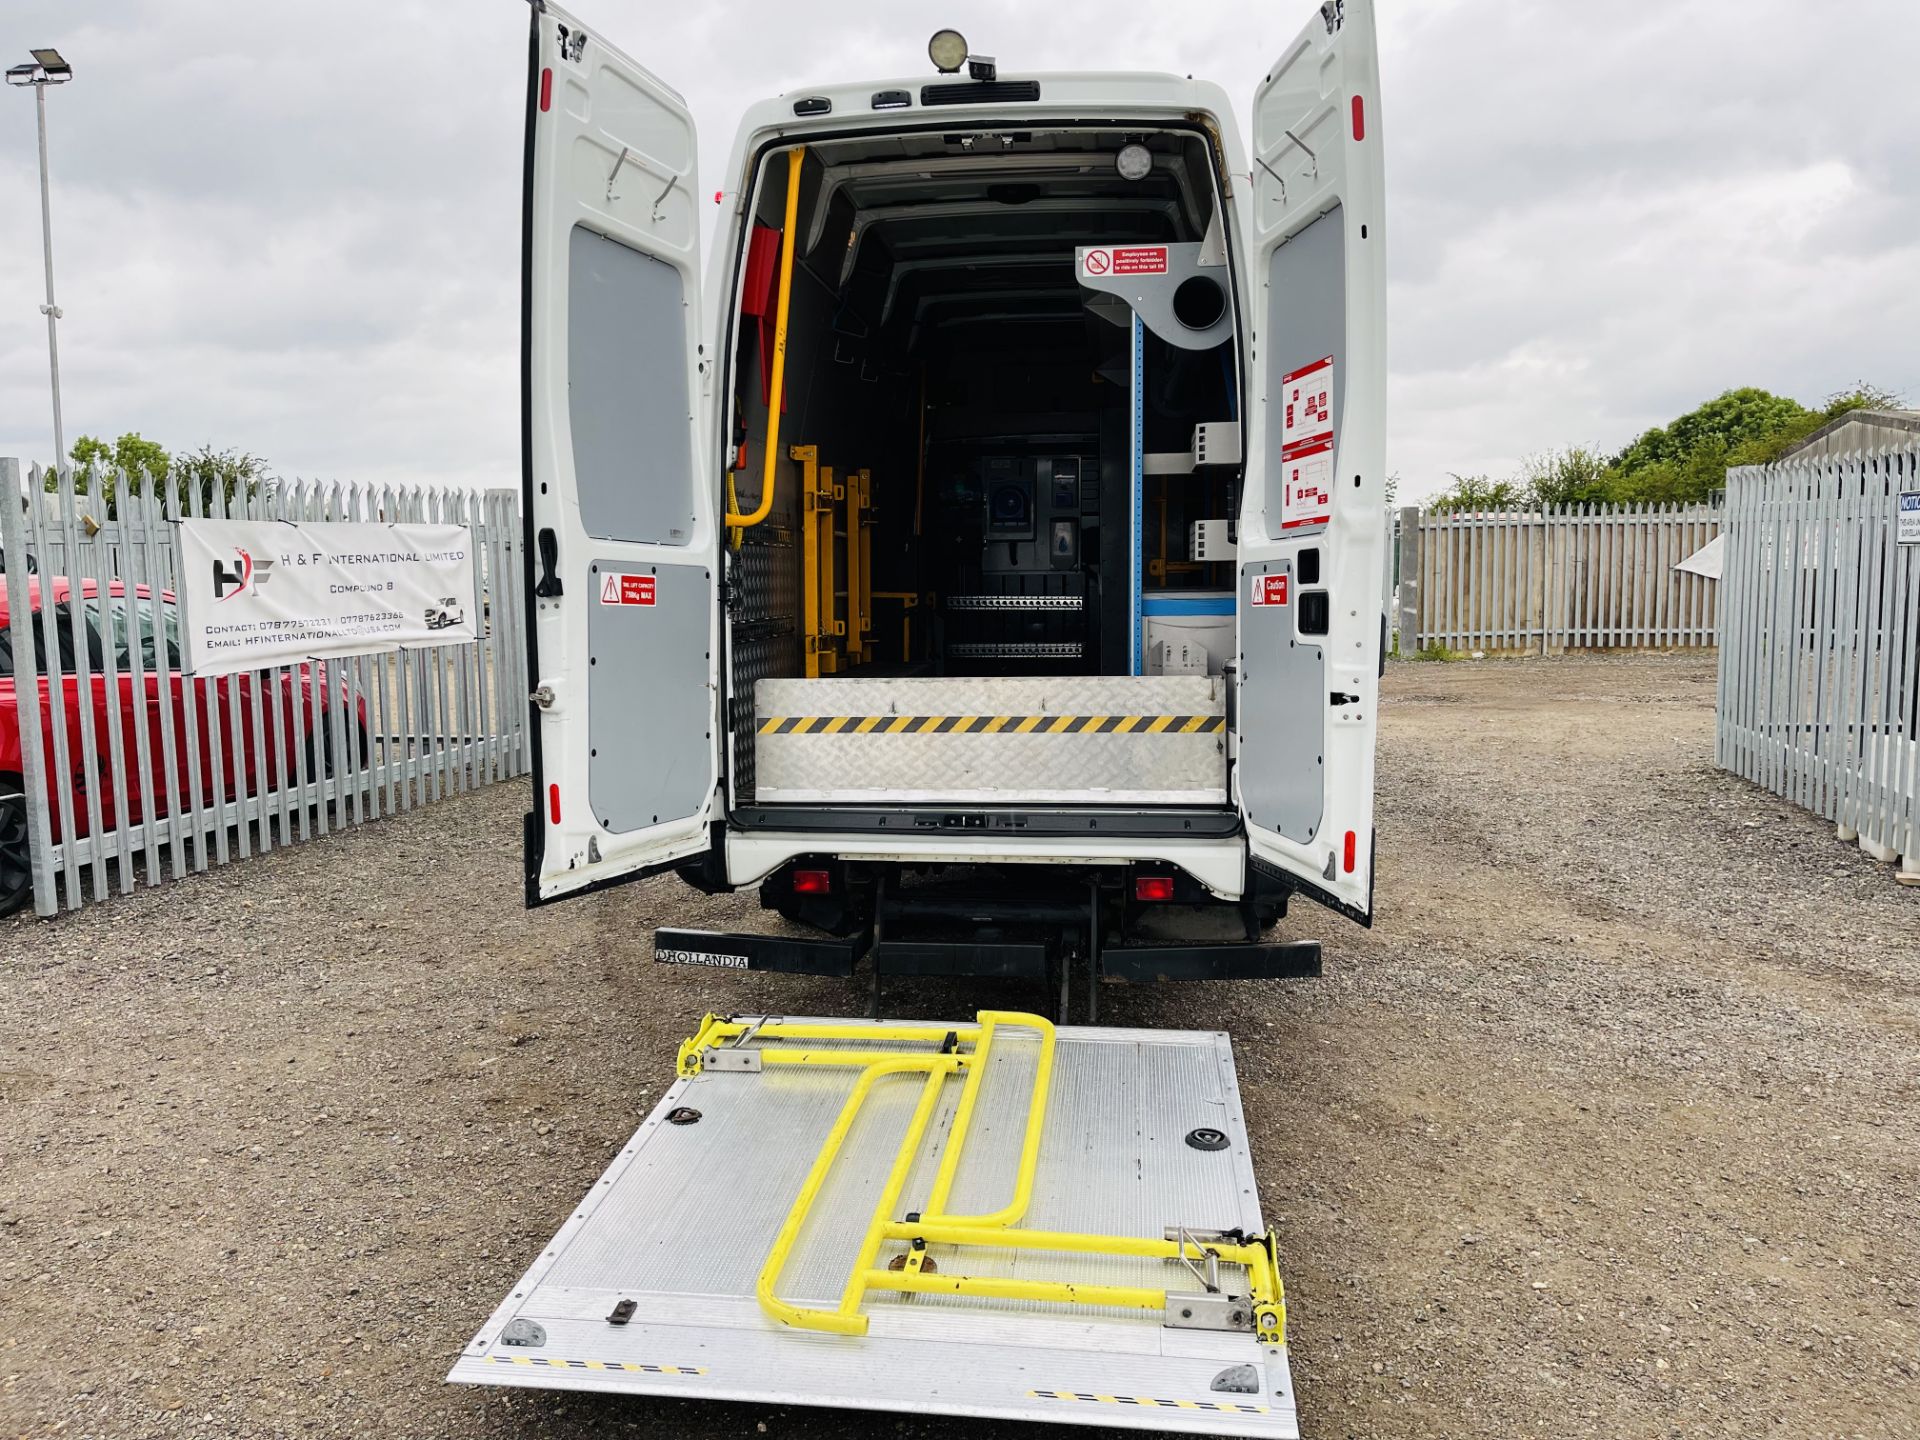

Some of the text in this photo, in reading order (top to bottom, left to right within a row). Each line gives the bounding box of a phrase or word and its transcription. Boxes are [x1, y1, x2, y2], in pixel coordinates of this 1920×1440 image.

[281, 551, 464, 566] H & F INTERNATIONAL LIMITED
[640, 591, 652, 600] MAX
[205, 623, 256, 634] CONTACT:
[207, 639, 241, 649] EMAIL:
[656, 949, 747, 969] DHOLLANDIA
